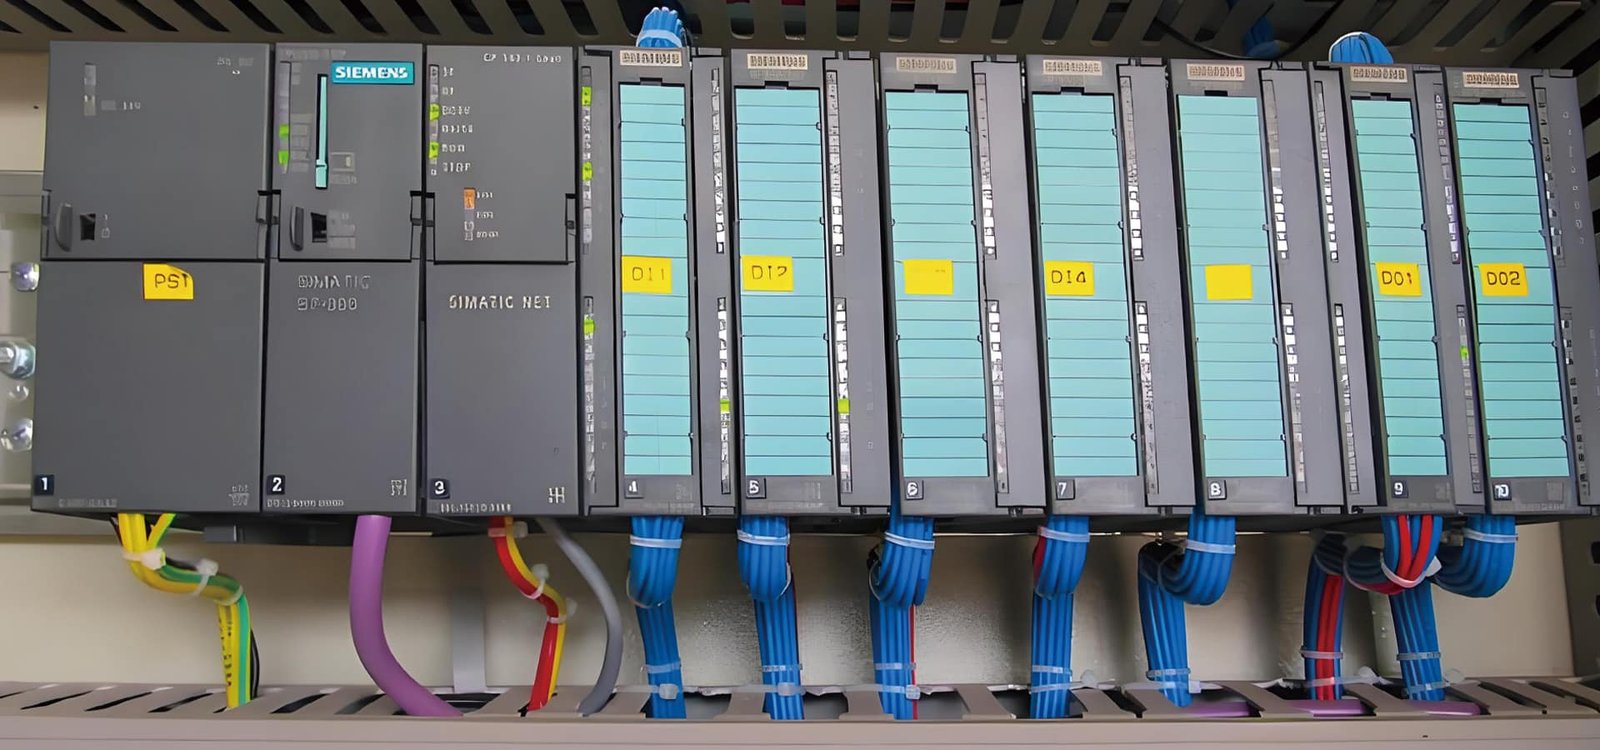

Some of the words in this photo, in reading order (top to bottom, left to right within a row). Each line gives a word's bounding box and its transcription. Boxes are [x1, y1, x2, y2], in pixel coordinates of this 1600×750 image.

[335, 66, 410, 80] SIEMENS
[448, 294, 514, 309] SIMATIC
[522, 295, 551, 309] NET
[40, 476, 48, 490] 1
[272, 477, 283, 492] 2
[434, 480, 445, 495] 3
[748, 481, 760, 495] 5
[906, 482, 919, 496] 6
[1057, 482, 1068, 496] 7
[1393, 482, 1404, 496] 9
